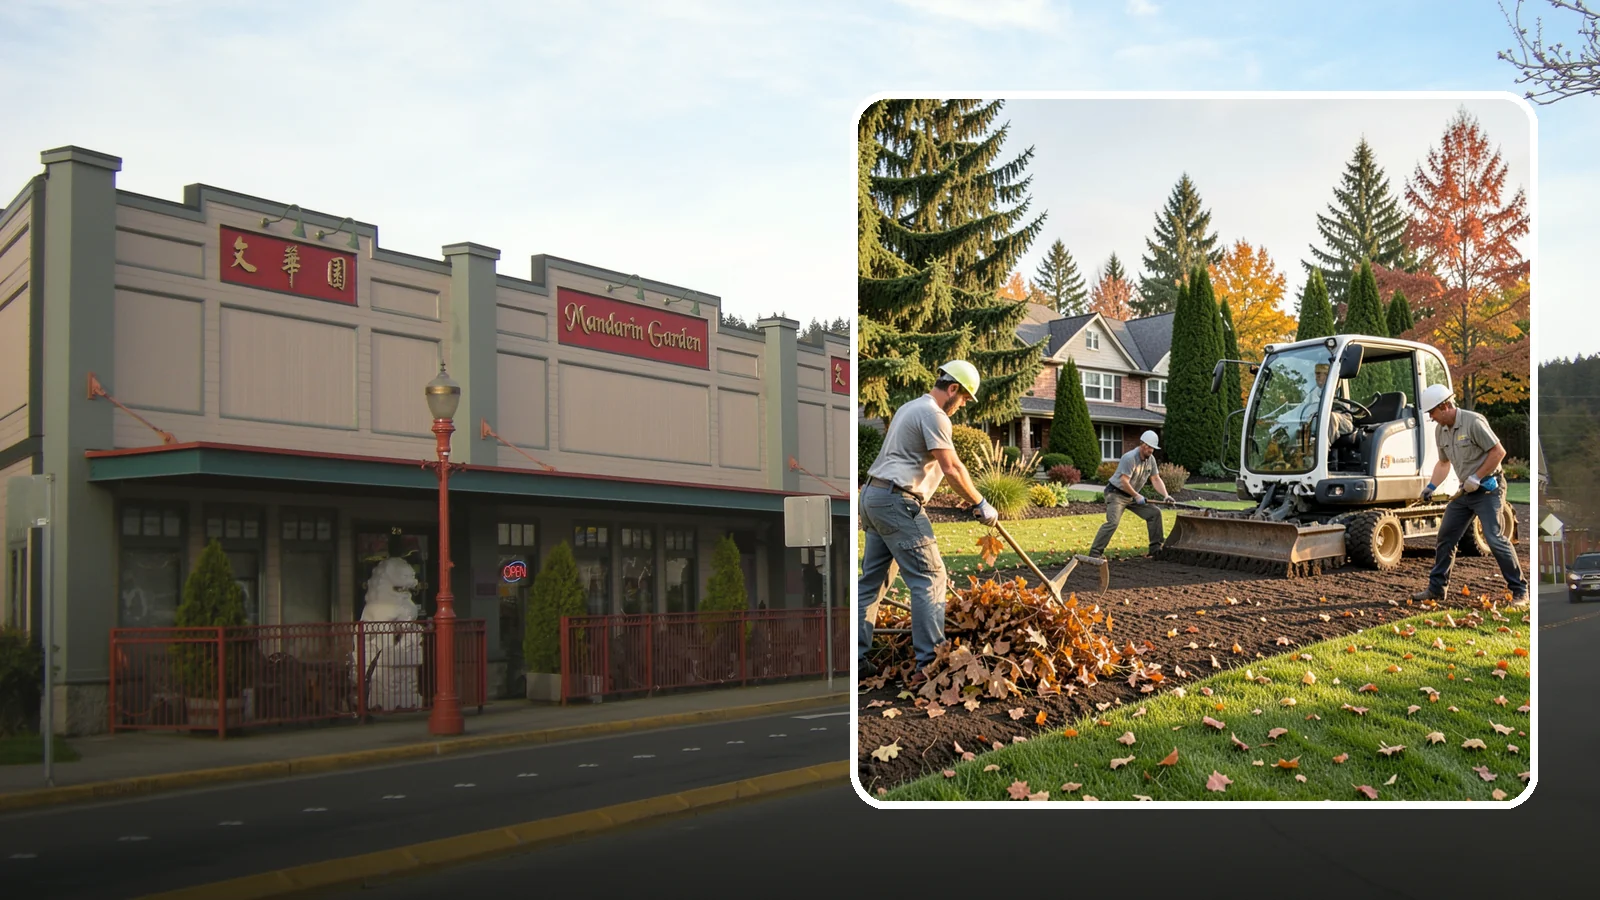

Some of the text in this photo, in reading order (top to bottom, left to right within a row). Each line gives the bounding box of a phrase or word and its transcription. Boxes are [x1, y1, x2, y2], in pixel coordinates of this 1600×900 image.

[231, 236, 346, 290] 文華園
[565, 302, 702, 352] Mandarin Garden
[503, 565, 527, 578] OPEN
